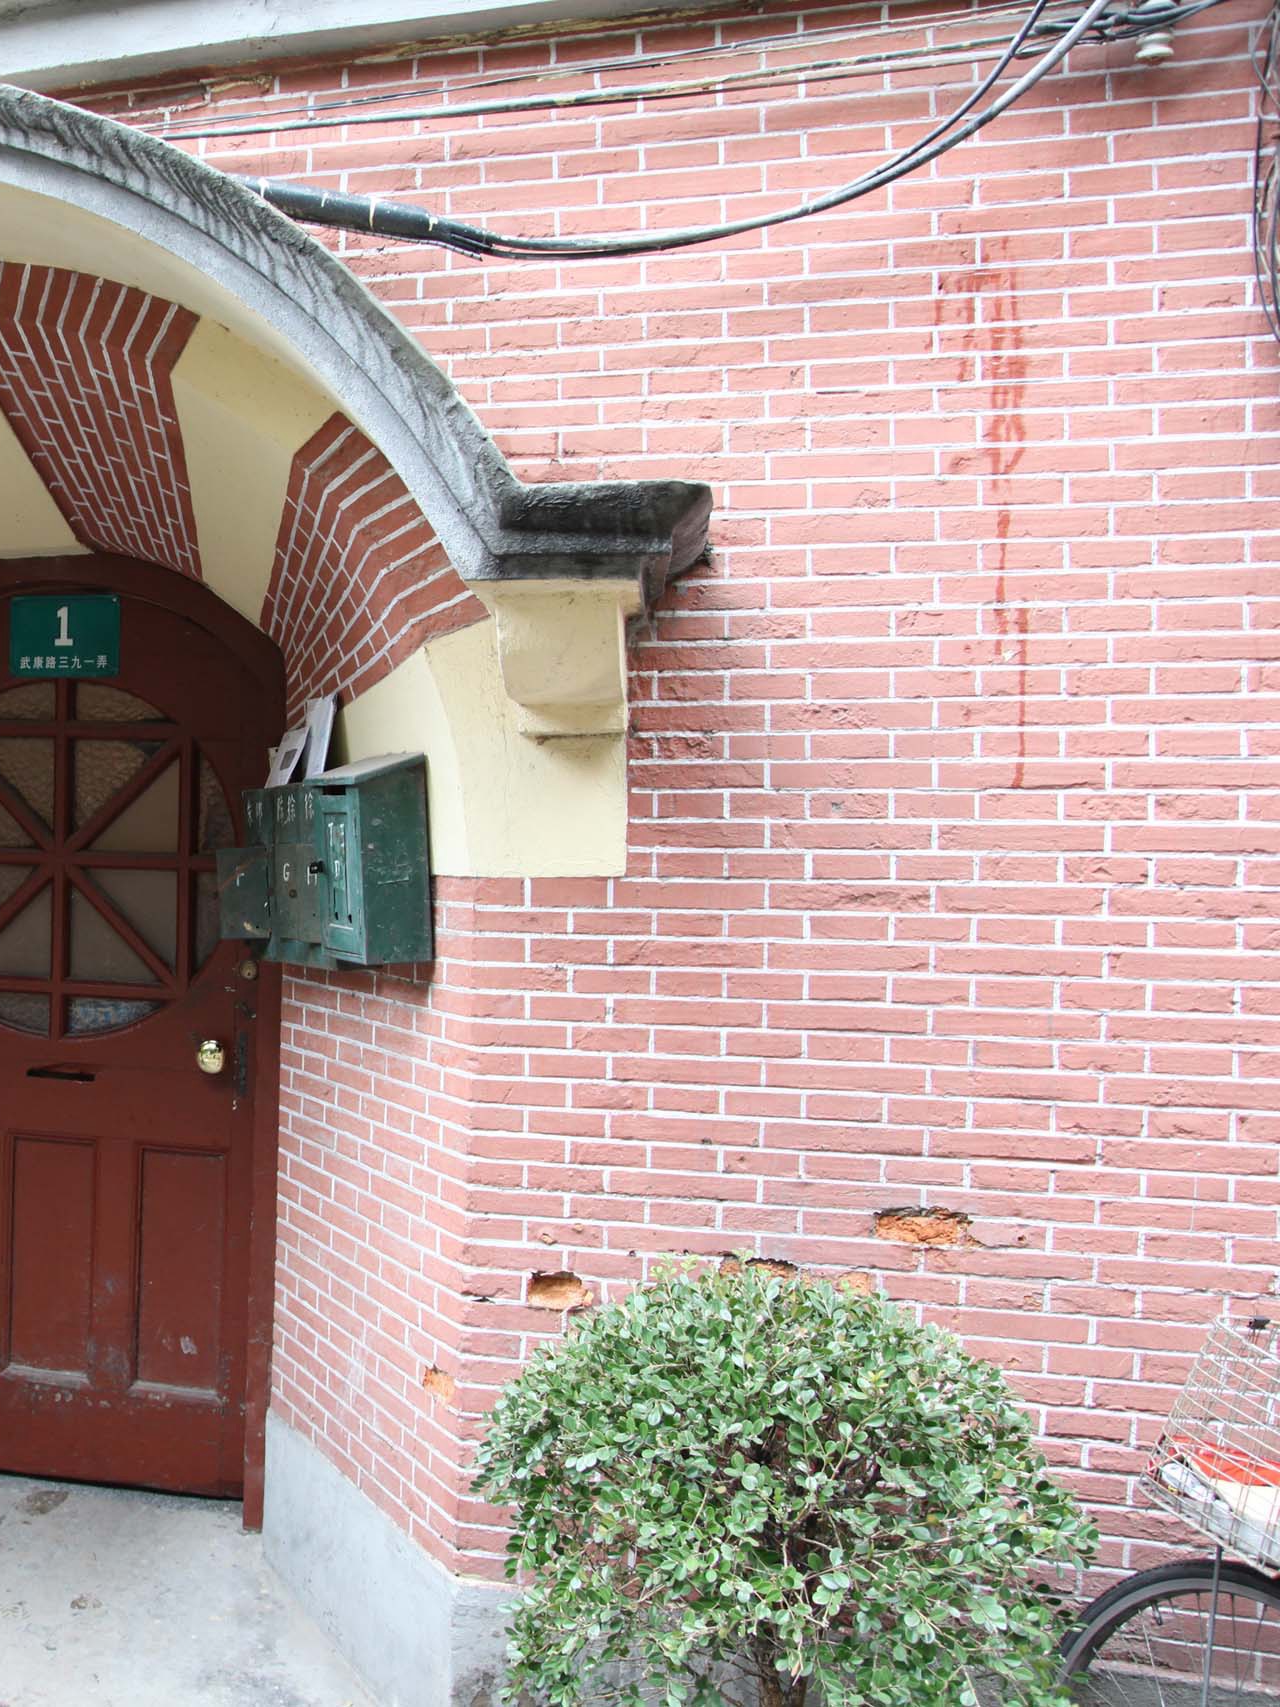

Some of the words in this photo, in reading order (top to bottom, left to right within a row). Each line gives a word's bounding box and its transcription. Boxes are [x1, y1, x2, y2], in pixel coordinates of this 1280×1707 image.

[54, 605, 74, 647] 1
[19, 654, 108, 670] 武康路三九一弄
[282, 862, 290, 882] G
